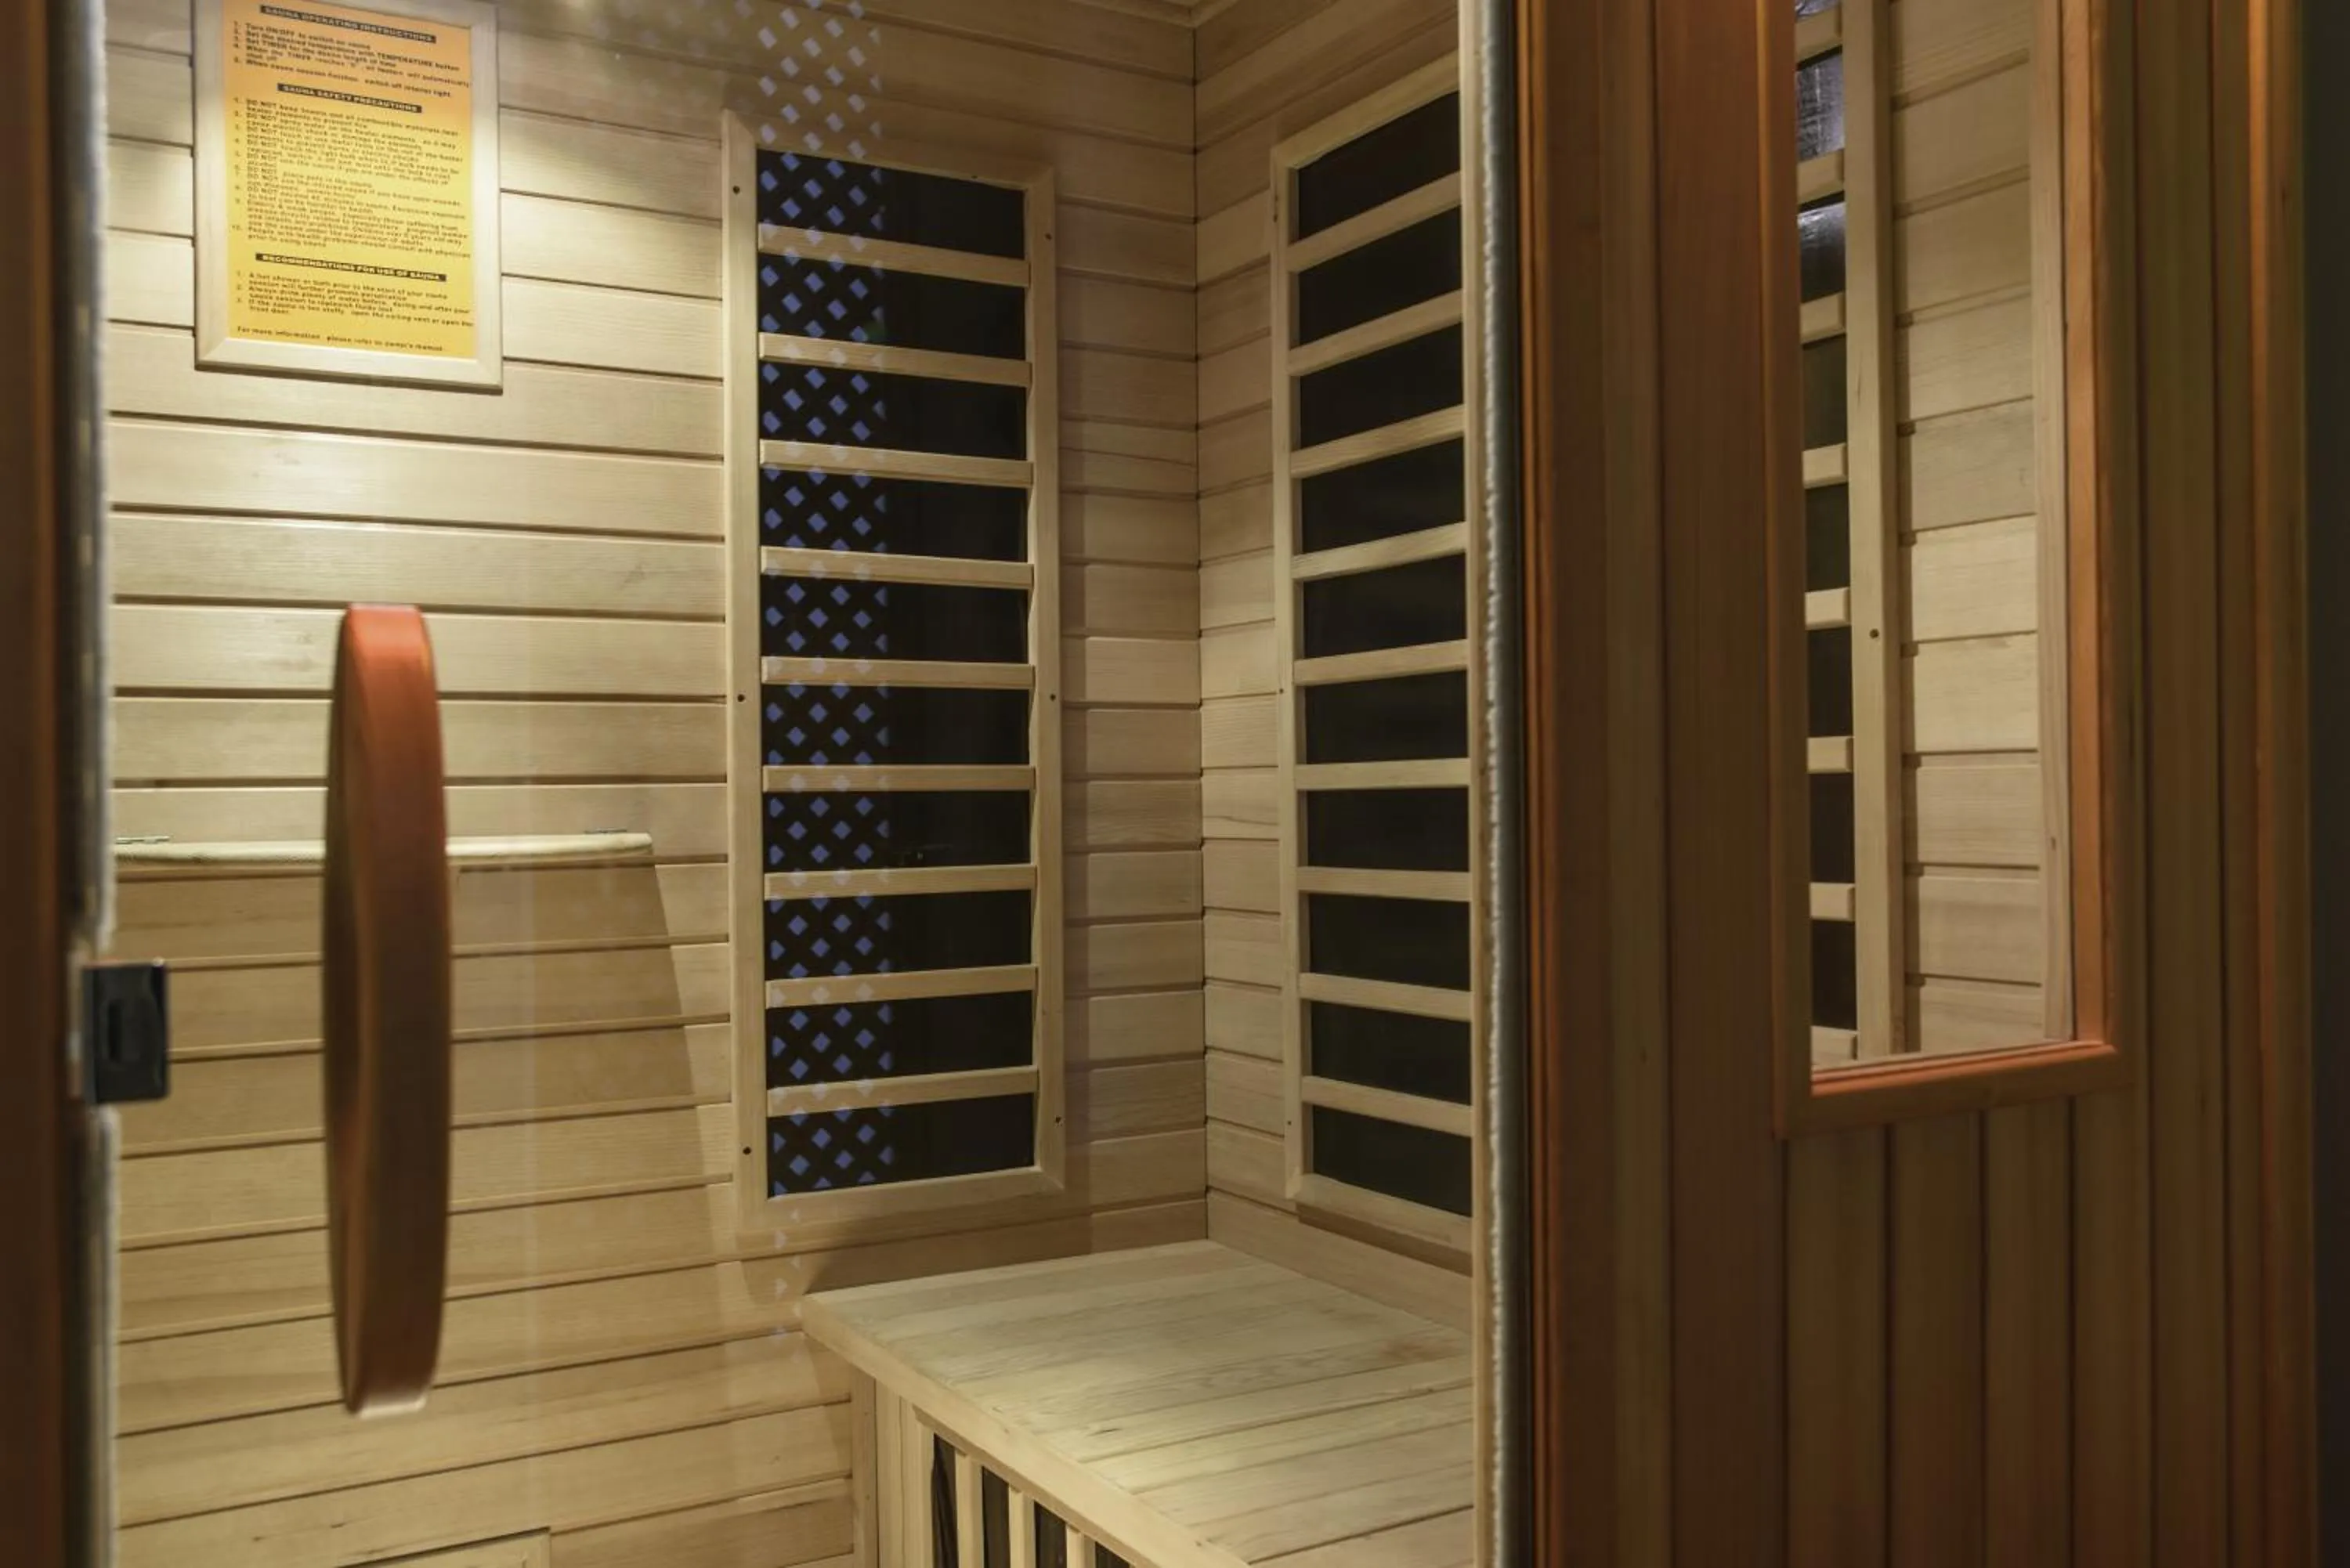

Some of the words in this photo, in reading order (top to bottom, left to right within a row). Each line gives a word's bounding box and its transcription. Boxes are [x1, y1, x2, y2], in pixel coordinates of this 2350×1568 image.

[264, 6, 298, 18] SAUNA
[301, 13, 358, 28] OPERATING
[360, 23, 432, 42] INSTRUCTIONS
[282, 85, 315, 96] SAUNA
[316, 90, 351, 101] SAFETY
[353, 96, 417, 111] PRECAUTIONS
[262, 255, 355, 270] RECOMMENDATIONS
[410, 271, 439, 280] SAUNA
